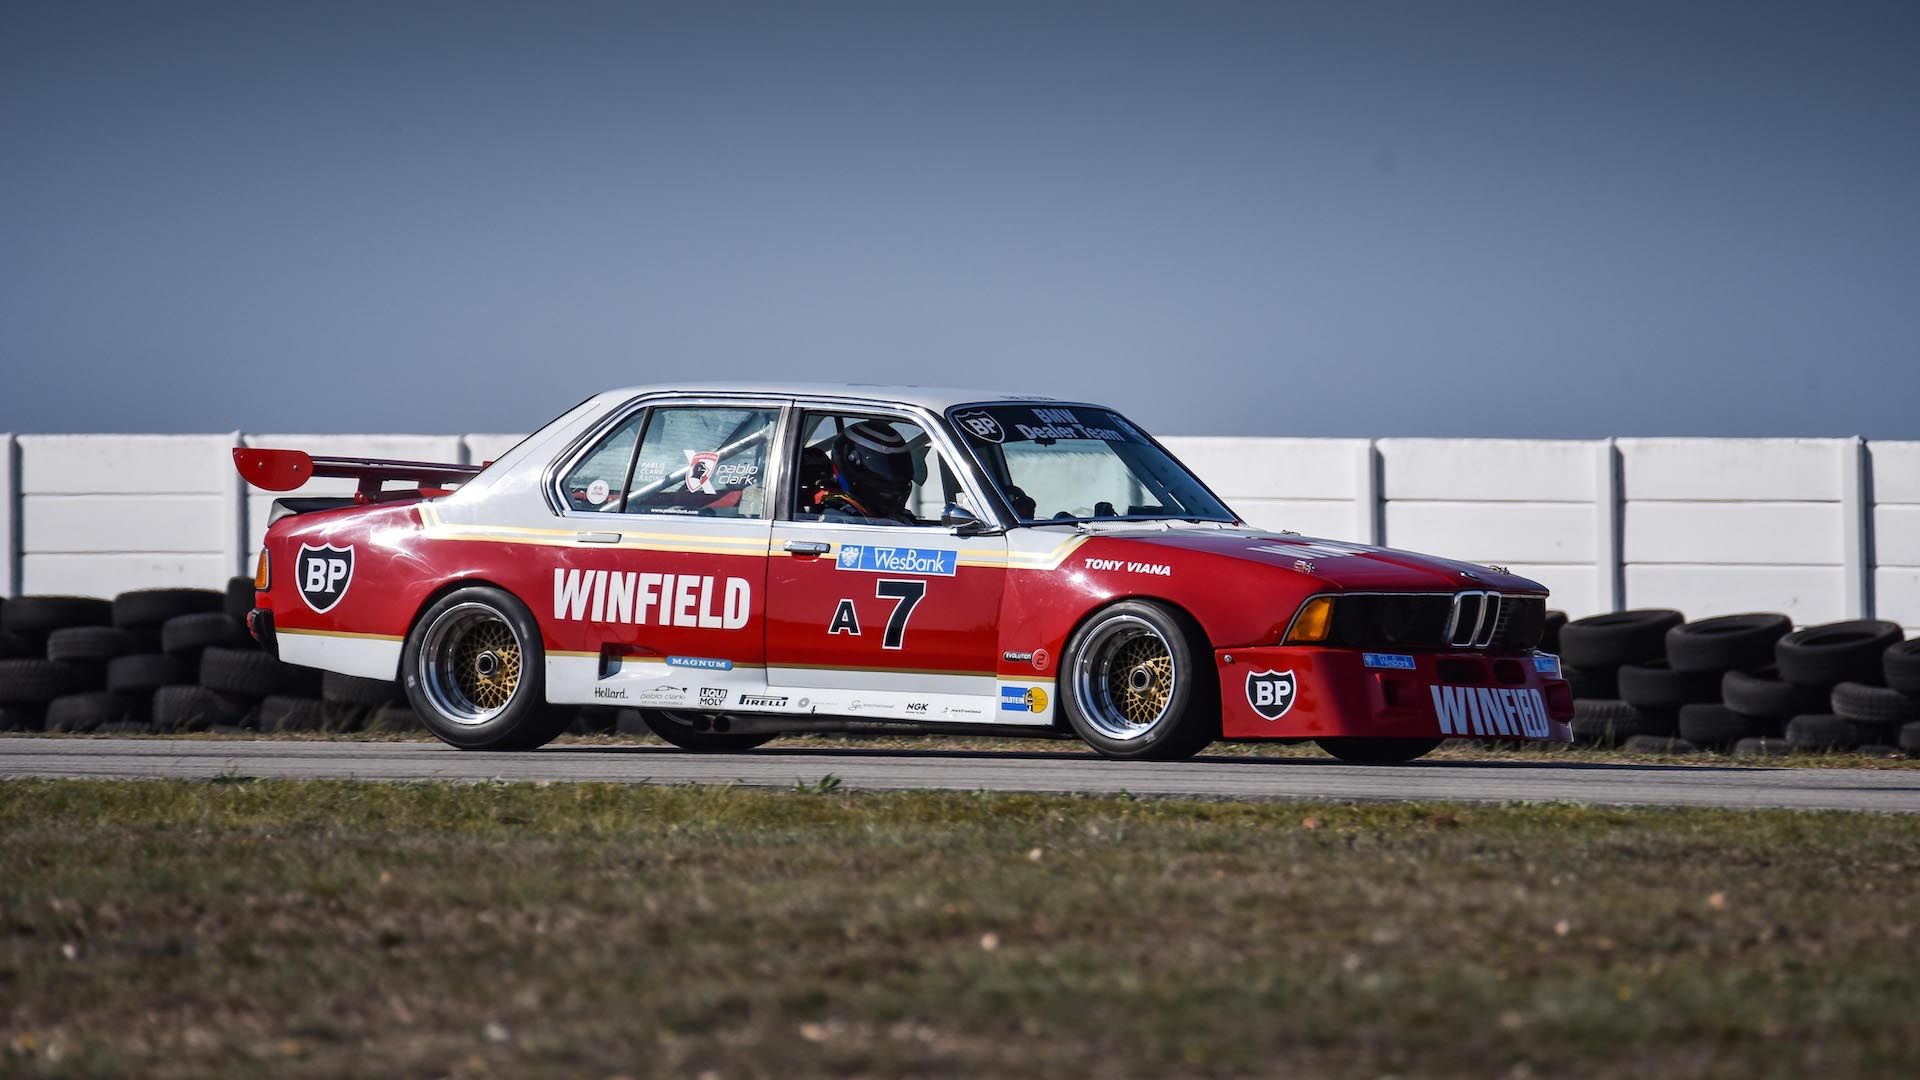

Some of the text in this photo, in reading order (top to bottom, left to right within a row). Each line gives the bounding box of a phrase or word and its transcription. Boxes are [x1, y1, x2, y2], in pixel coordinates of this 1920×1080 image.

[1031, 408, 1079, 424] BMW
[965, 419, 997, 436] BP
[1015, 424, 1080, 440] Dealer
[1075, 425, 1126, 442] Team
[716, 463, 758, 476] pablo
[874, 547, 945, 573] WesBank
[1084, 558, 1171, 576] TONY VIANA
[304, 557, 348, 593] BP
[554, 567, 751, 630] WINFIELD
[828, 578, 927, 650] A 7
[671, 657, 727, 668] MAGNUM
[700, 697, 724, 706] MOLY
[701, 688, 727, 698] LIQUI
[739, 694, 789, 707] PIRELLI
[1001, 696, 1025, 704] BILSTEIN
[1254, 680, 1292, 707] BP
[906, 703, 929, 711] NGK
[1429, 684, 1550, 738] WINFIELD
